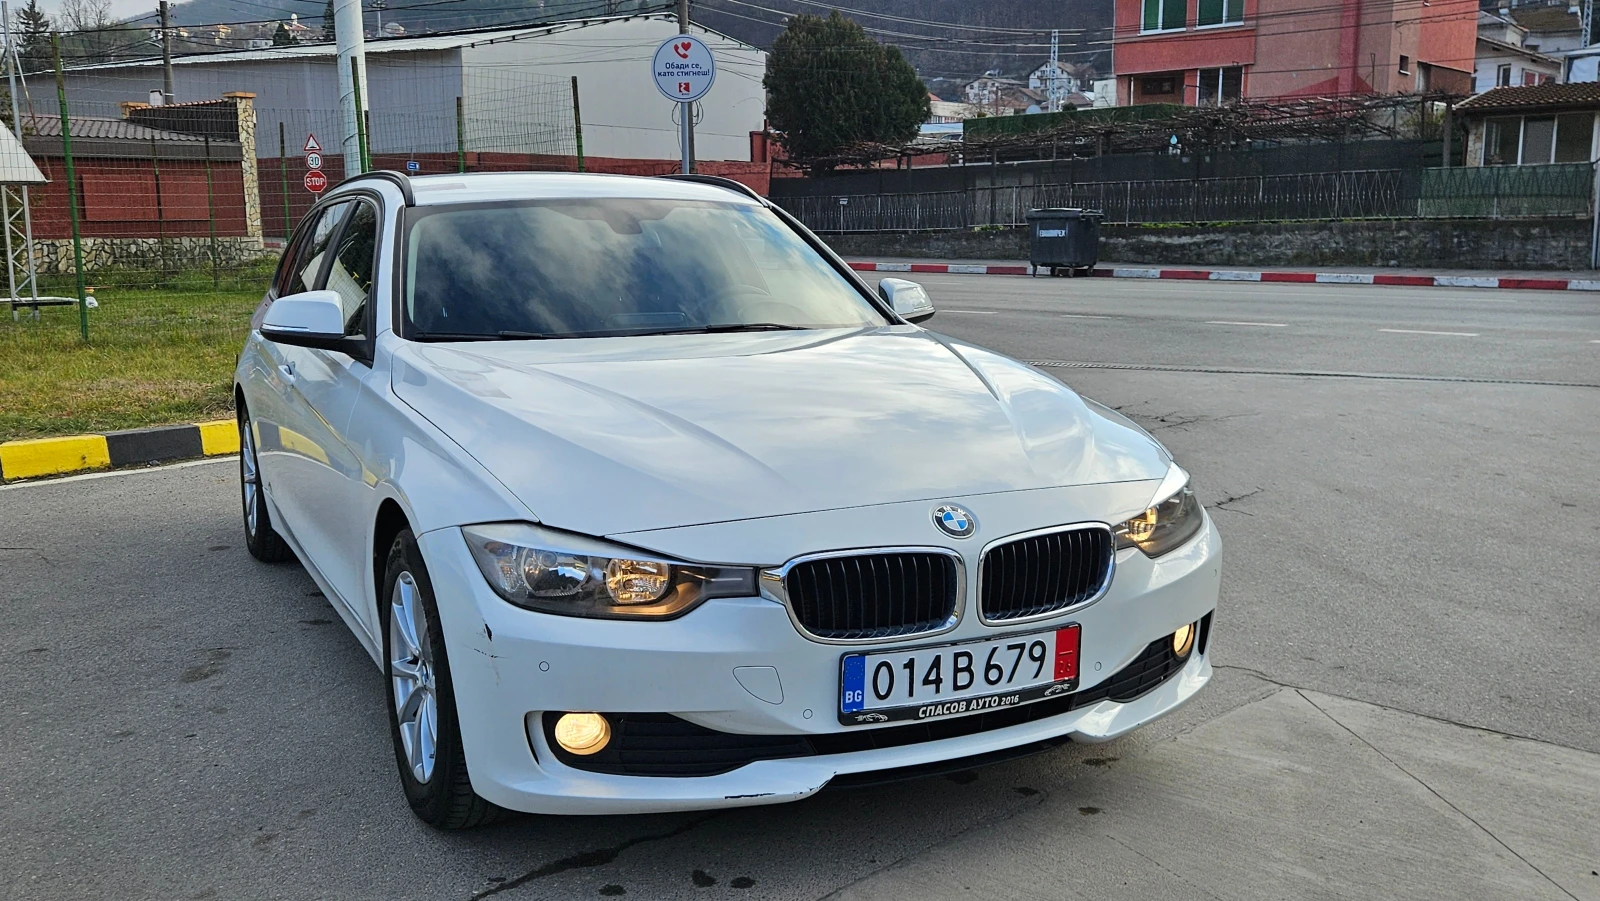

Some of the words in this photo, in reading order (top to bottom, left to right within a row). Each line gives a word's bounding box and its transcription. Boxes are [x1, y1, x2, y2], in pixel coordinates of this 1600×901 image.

[665, 62, 689, 70] Обади
[309, 156, 320, 166] 30
[306, 177, 325, 186] STOP
[845, 690, 863, 704] BG
[919, 702, 967, 718] СПАСОВ
[969, 696, 999, 711] АУТО
[1001, 695, 1020, 706] 2016
